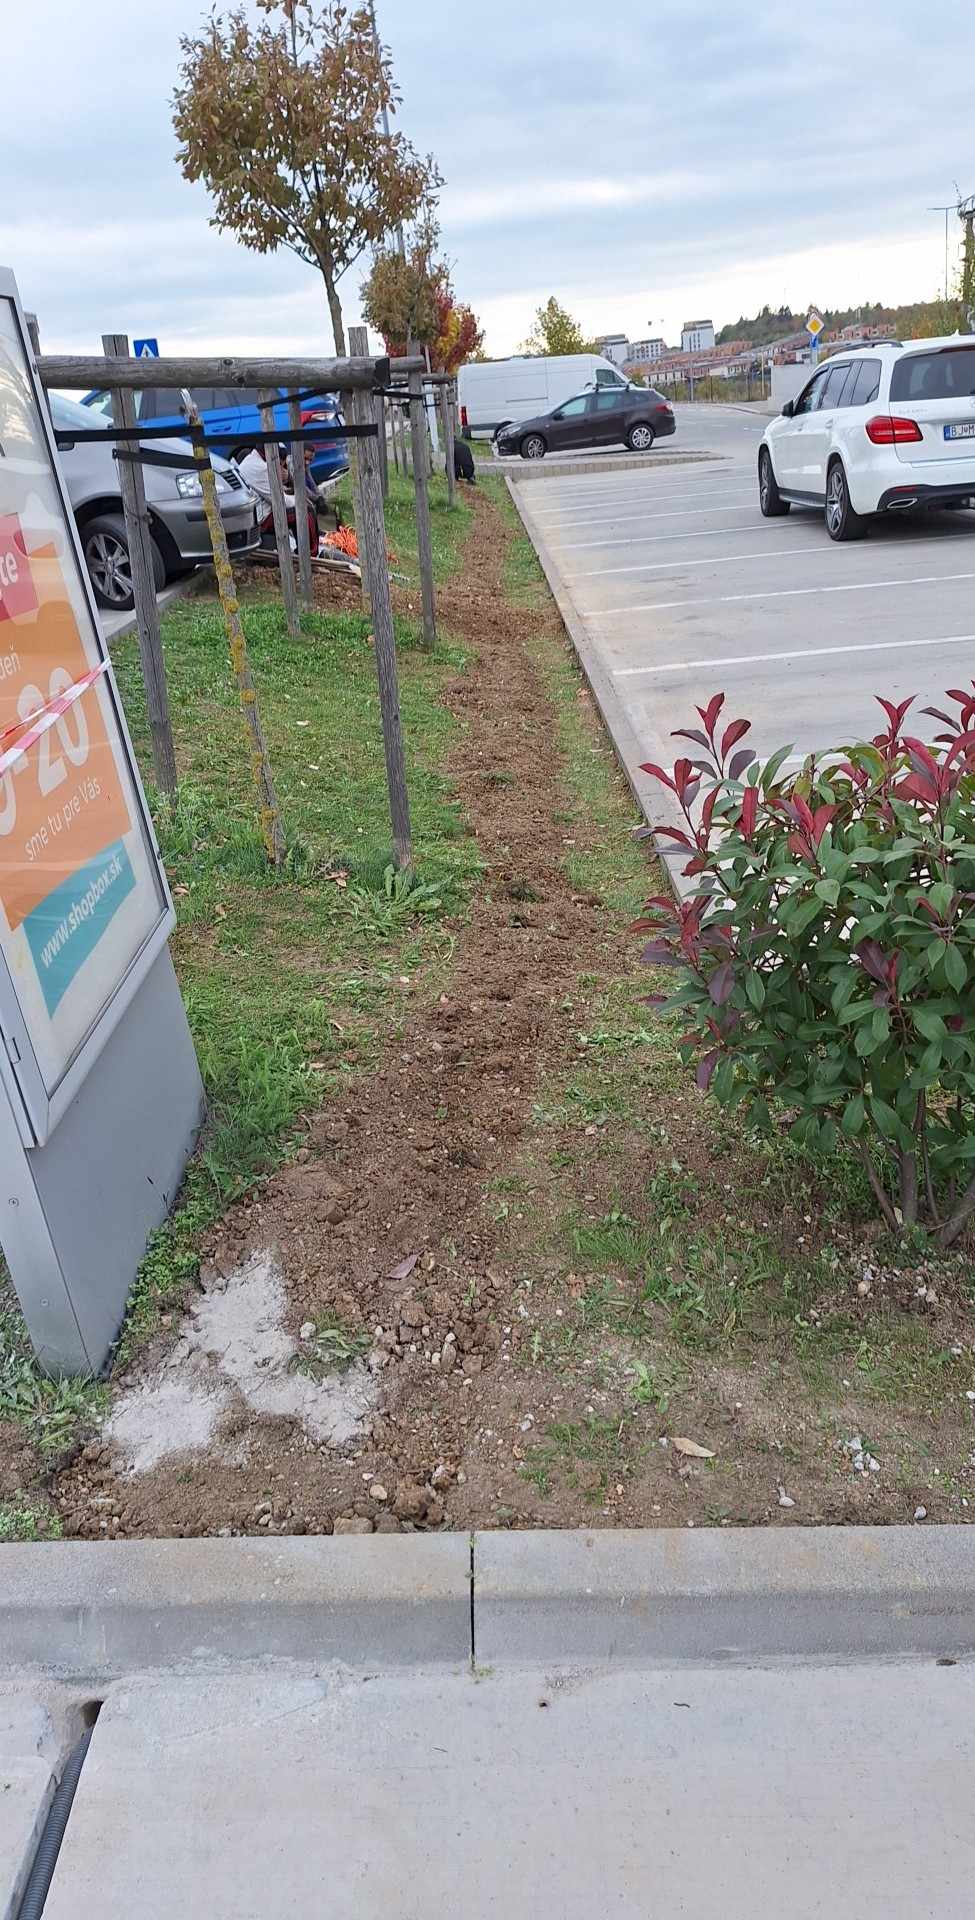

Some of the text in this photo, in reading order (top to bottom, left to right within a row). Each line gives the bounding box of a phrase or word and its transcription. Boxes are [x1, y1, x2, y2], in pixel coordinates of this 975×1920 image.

[25, 777, 101, 861] sme tu pre Vás
[40, 855, 123, 969] www.shopbox.sk
